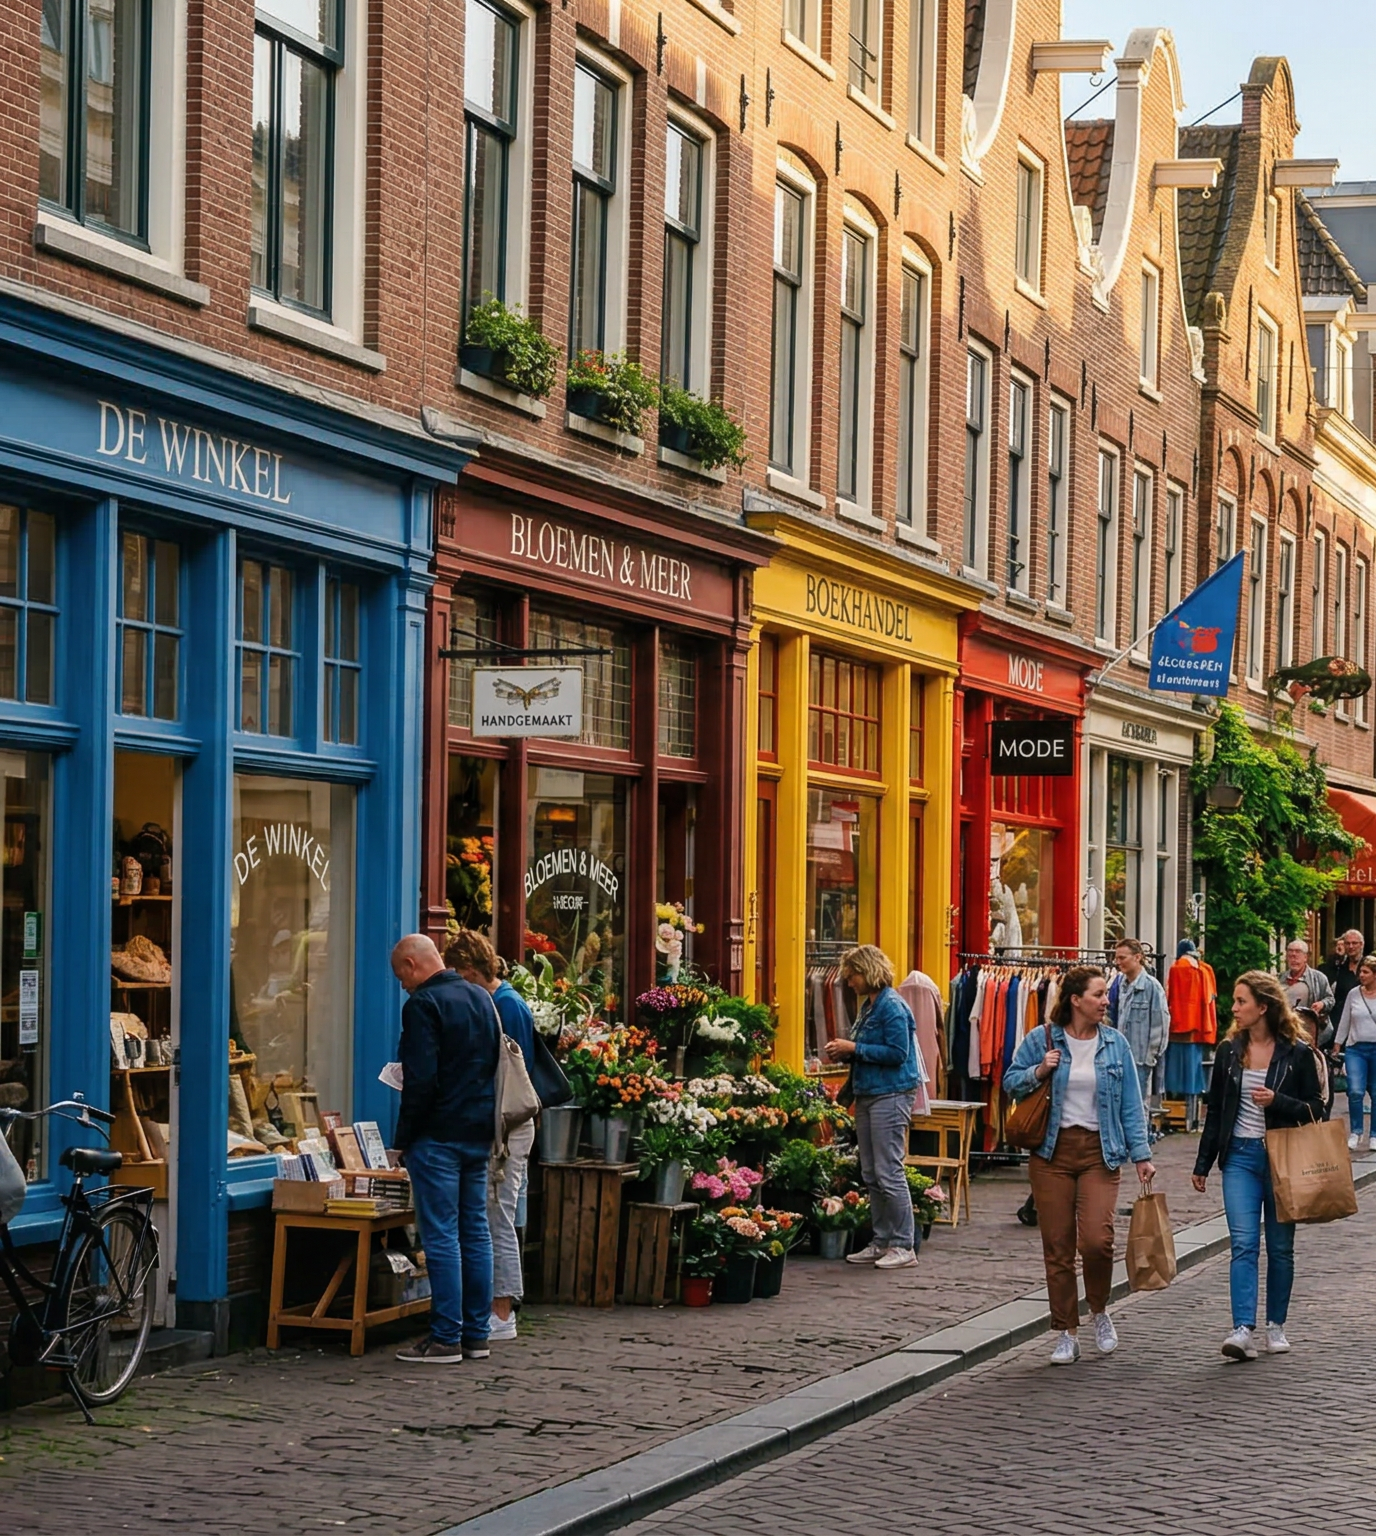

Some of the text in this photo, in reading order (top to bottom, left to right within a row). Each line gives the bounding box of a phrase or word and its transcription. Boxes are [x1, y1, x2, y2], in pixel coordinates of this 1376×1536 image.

[96, 400, 292, 504] DE WINKEL
[510, 513, 692, 600] BLOEMEN & MEER
[806, 574, 913, 643] BOEKHANDEL
[1008, 653, 1044, 692] MODE
[481, 715, 573, 726] HANDGEMAAKT
[999, 739, 1065, 757] MODE
[233, 823, 330, 891] DE WINKEL
[524, 848, 619, 903] BLOEMEN & MEER
